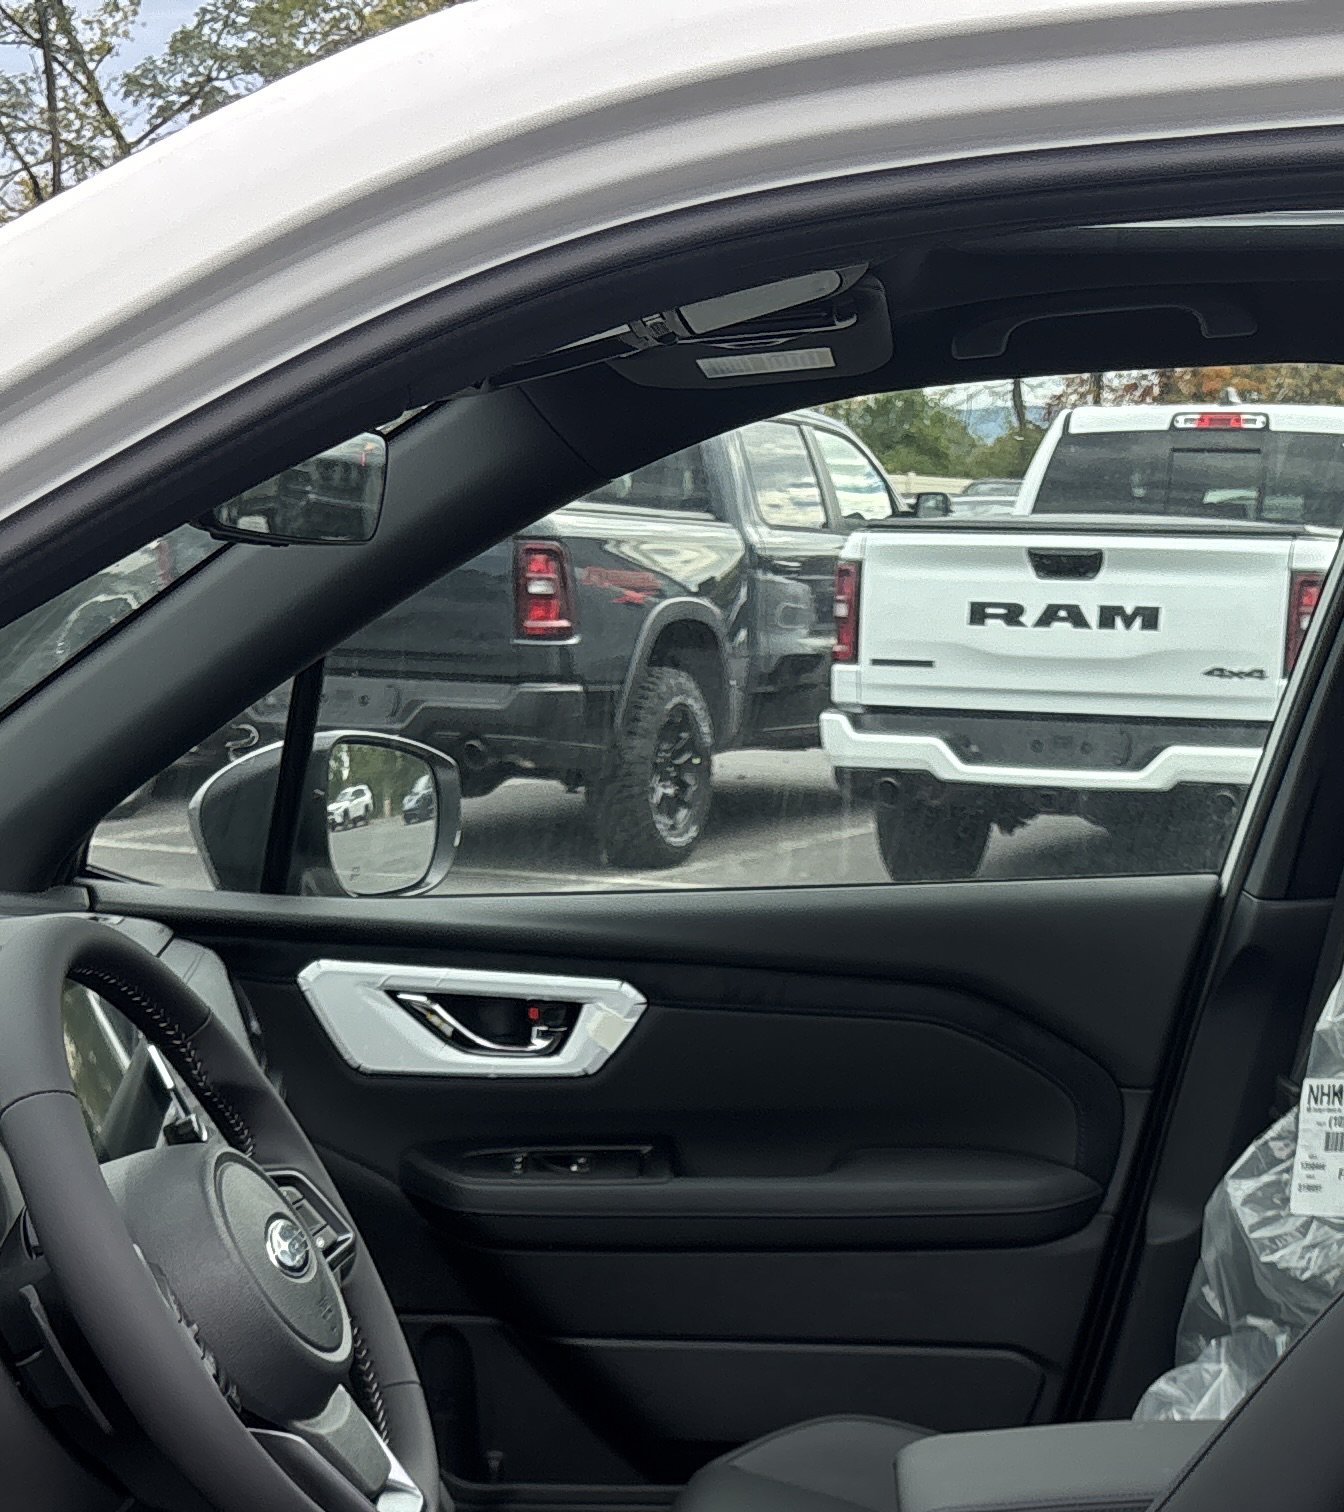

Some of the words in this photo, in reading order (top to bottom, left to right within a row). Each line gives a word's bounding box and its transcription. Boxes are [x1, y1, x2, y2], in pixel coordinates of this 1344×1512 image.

[967, 601, 1162, 631] RAM
[1201, 667, 1269, 680] 4x4
[1307, 1084, 1344, 1106] NHK
